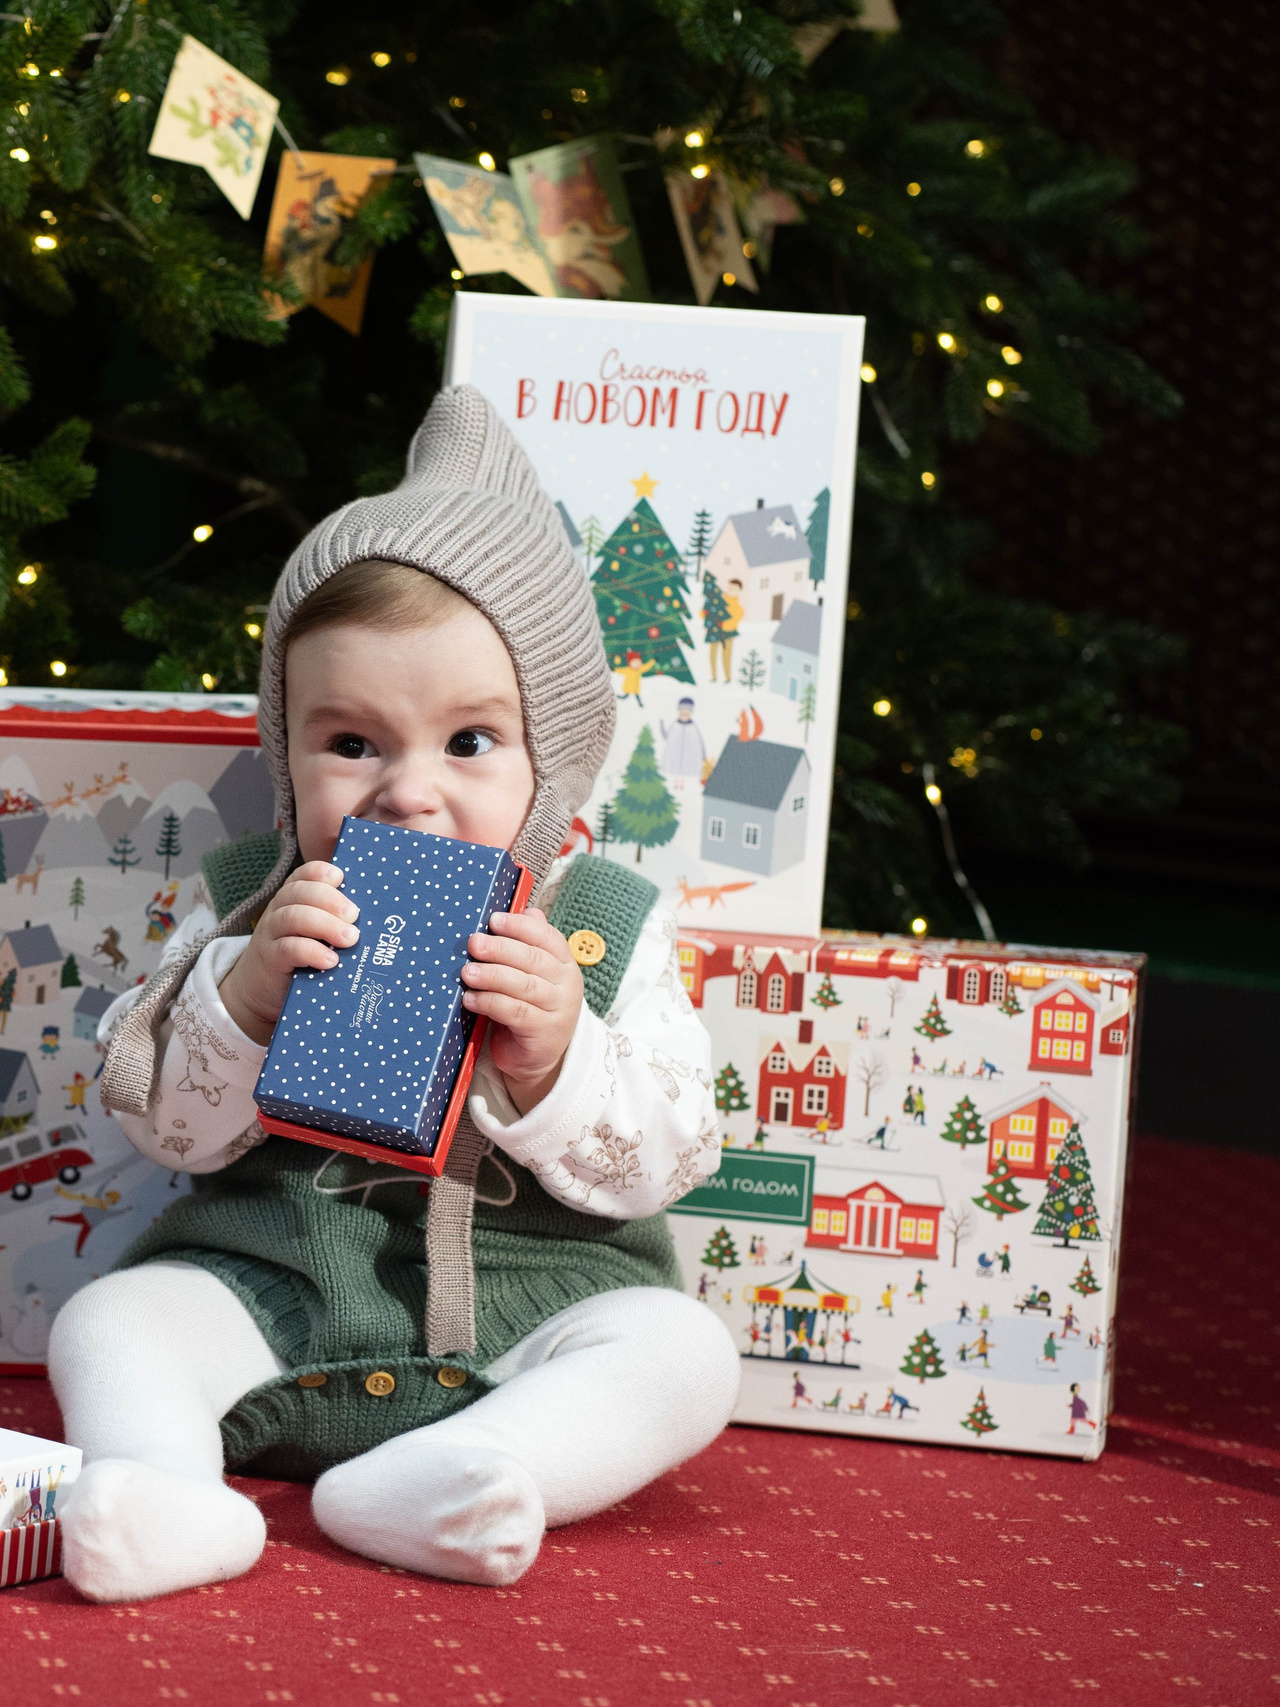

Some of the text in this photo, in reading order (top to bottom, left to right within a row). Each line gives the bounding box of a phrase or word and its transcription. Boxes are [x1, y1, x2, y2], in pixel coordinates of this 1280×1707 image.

[515, 377, 790, 439] В НОВОМ ГОДУ
[372, 933, 391, 966] LAND
[381, 935, 401, 966] SIMA
[350, 945, 371, 994] SIMA-LAND.RU
[731, 1176, 799, 1197] ГОДОМ
